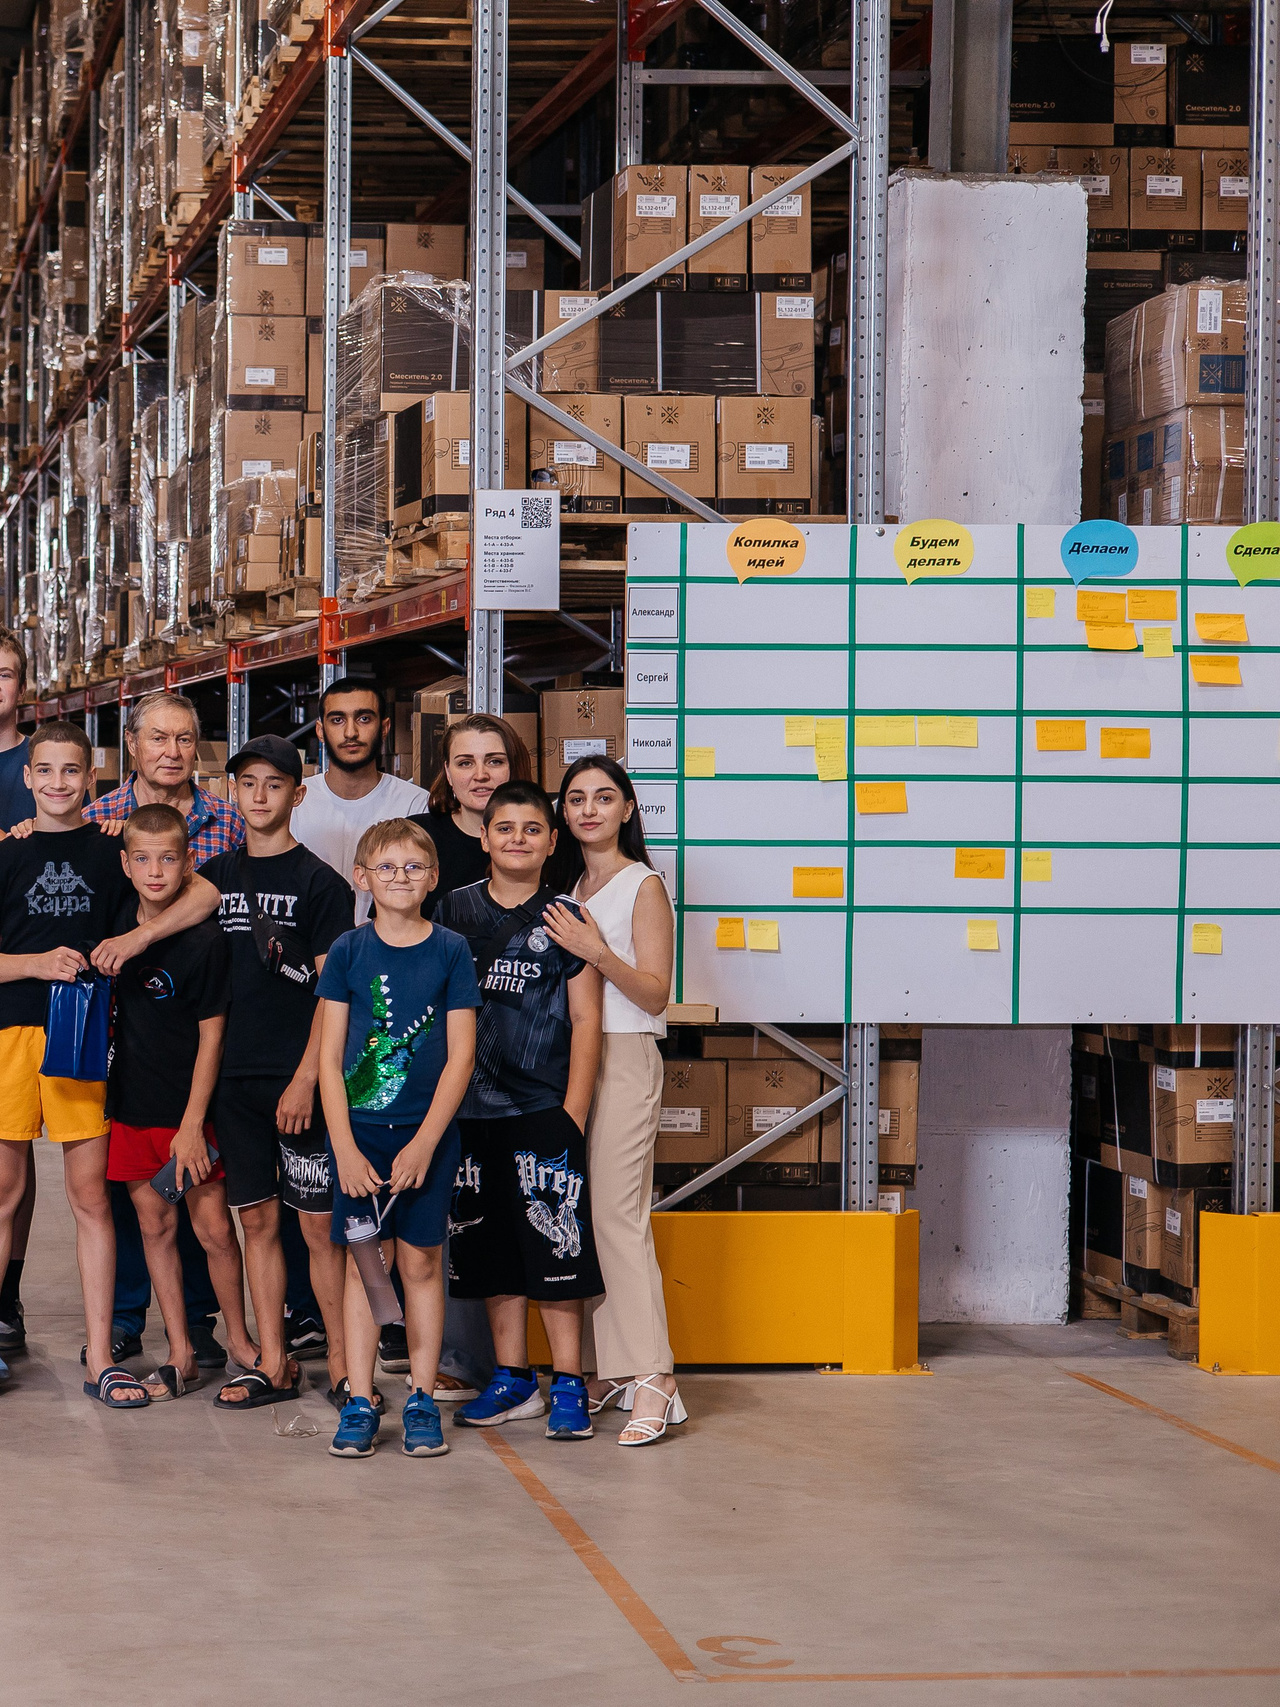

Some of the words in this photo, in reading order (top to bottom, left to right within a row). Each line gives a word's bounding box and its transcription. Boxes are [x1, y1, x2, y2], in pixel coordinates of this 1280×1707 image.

[1043, 101, 1056, 109] 2.0
[1186, 104, 1227, 112] Смеситель
[390, 372, 429, 380] Смеситель
[485, 508, 506, 518] Ряд
[509, 508, 515, 517] 4
[733, 536, 800, 549] Копилка
[909, 536, 960, 550] Будем
[1068, 542, 1130, 555] Делаем
[1233, 544, 1280, 556] Сдела
[746, 557, 786, 569] идей
[906, 557, 962, 569] делать
[632, 608, 675, 618] Александр
[636, 672, 669, 684] Сергей
[632, 738, 672, 748] Николай
[639, 804, 666, 815] Артур
[26, 895, 91, 916] Kappa
[280, 964, 306, 983] PUMA
[488, 959, 542, 978] rates
[484, 974, 526, 993] BETTER
[514, 1151, 584, 1209] Prey
